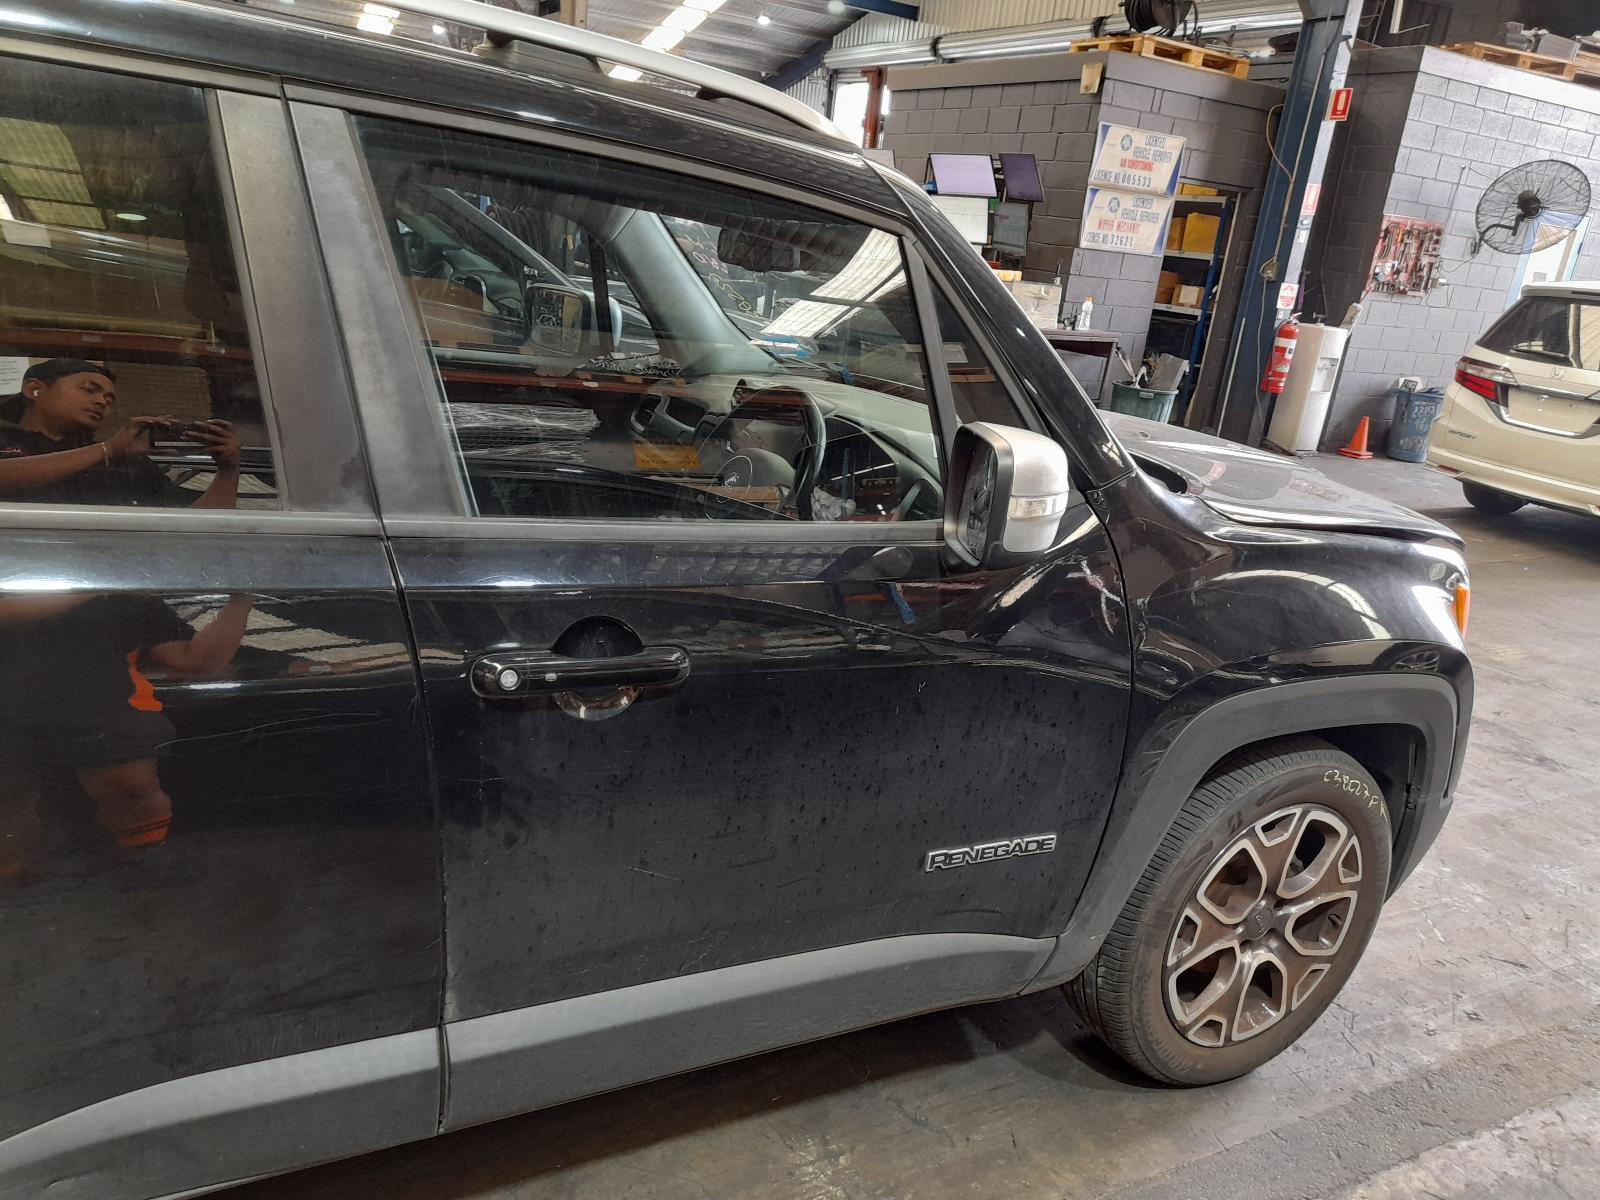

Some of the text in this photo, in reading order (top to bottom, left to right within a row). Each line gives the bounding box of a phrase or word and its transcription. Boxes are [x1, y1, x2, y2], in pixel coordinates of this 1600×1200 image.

[1121, 173, 1152, 188] 005533
[1109, 234, 1133, 247] 32621
[925, 834, 1056, 872] RENEGADE
